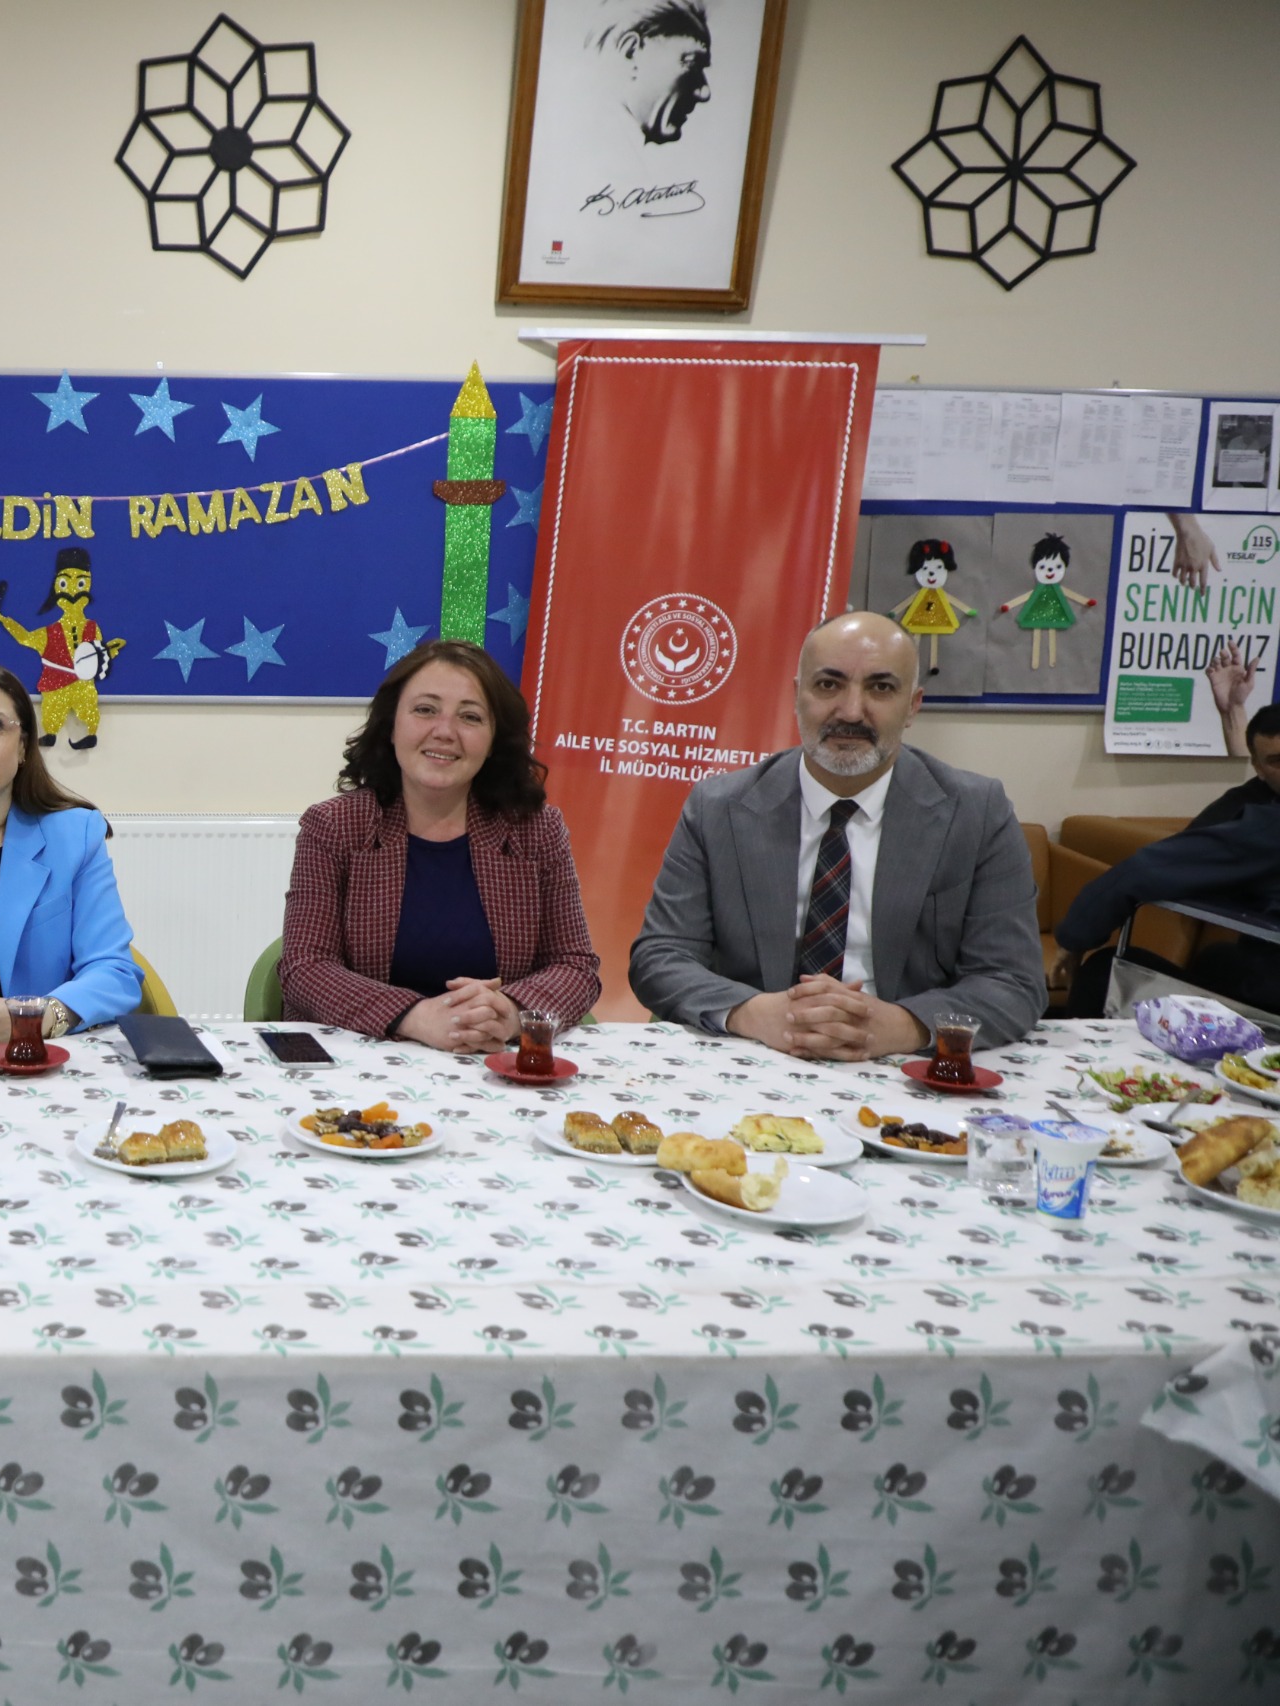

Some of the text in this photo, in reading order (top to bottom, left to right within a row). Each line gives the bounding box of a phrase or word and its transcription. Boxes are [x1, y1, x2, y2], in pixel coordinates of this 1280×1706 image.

[128, 461, 370, 539] RAMAZAN
[1128, 528, 1175, 573] BİZ
[1252, 536, 1272, 548] 115
[1218, 578, 1276, 630] İÇİN
[658, 614, 672, 625] AİLE
[682, 612, 705, 628] SOSYAL
[622, 718, 717, 741] T.C. BARTIN
[555, 732, 773, 766] AİLE VE SOSYAL HİZMETLE
[600, 756, 614, 773] İL
